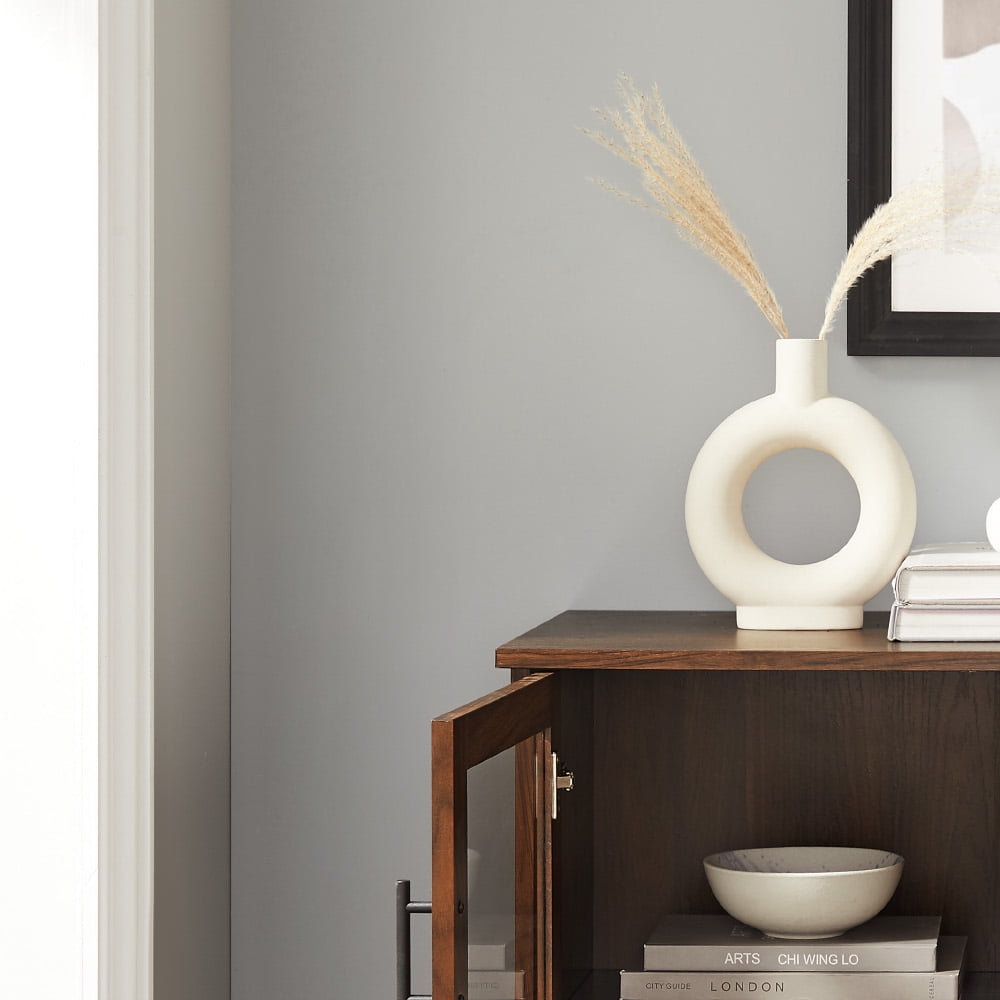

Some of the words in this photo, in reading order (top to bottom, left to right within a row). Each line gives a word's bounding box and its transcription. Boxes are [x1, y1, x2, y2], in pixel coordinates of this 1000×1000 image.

[724, 952, 761, 965] ARTS
[778, 953, 800, 965] CHI
[803, 953, 838, 965] WING
[841, 953, 859, 966] LO
[645, 982, 664, 990] CITY
[665, 982, 691, 990] GUIDE
[710, 981, 785, 992] LONDON
